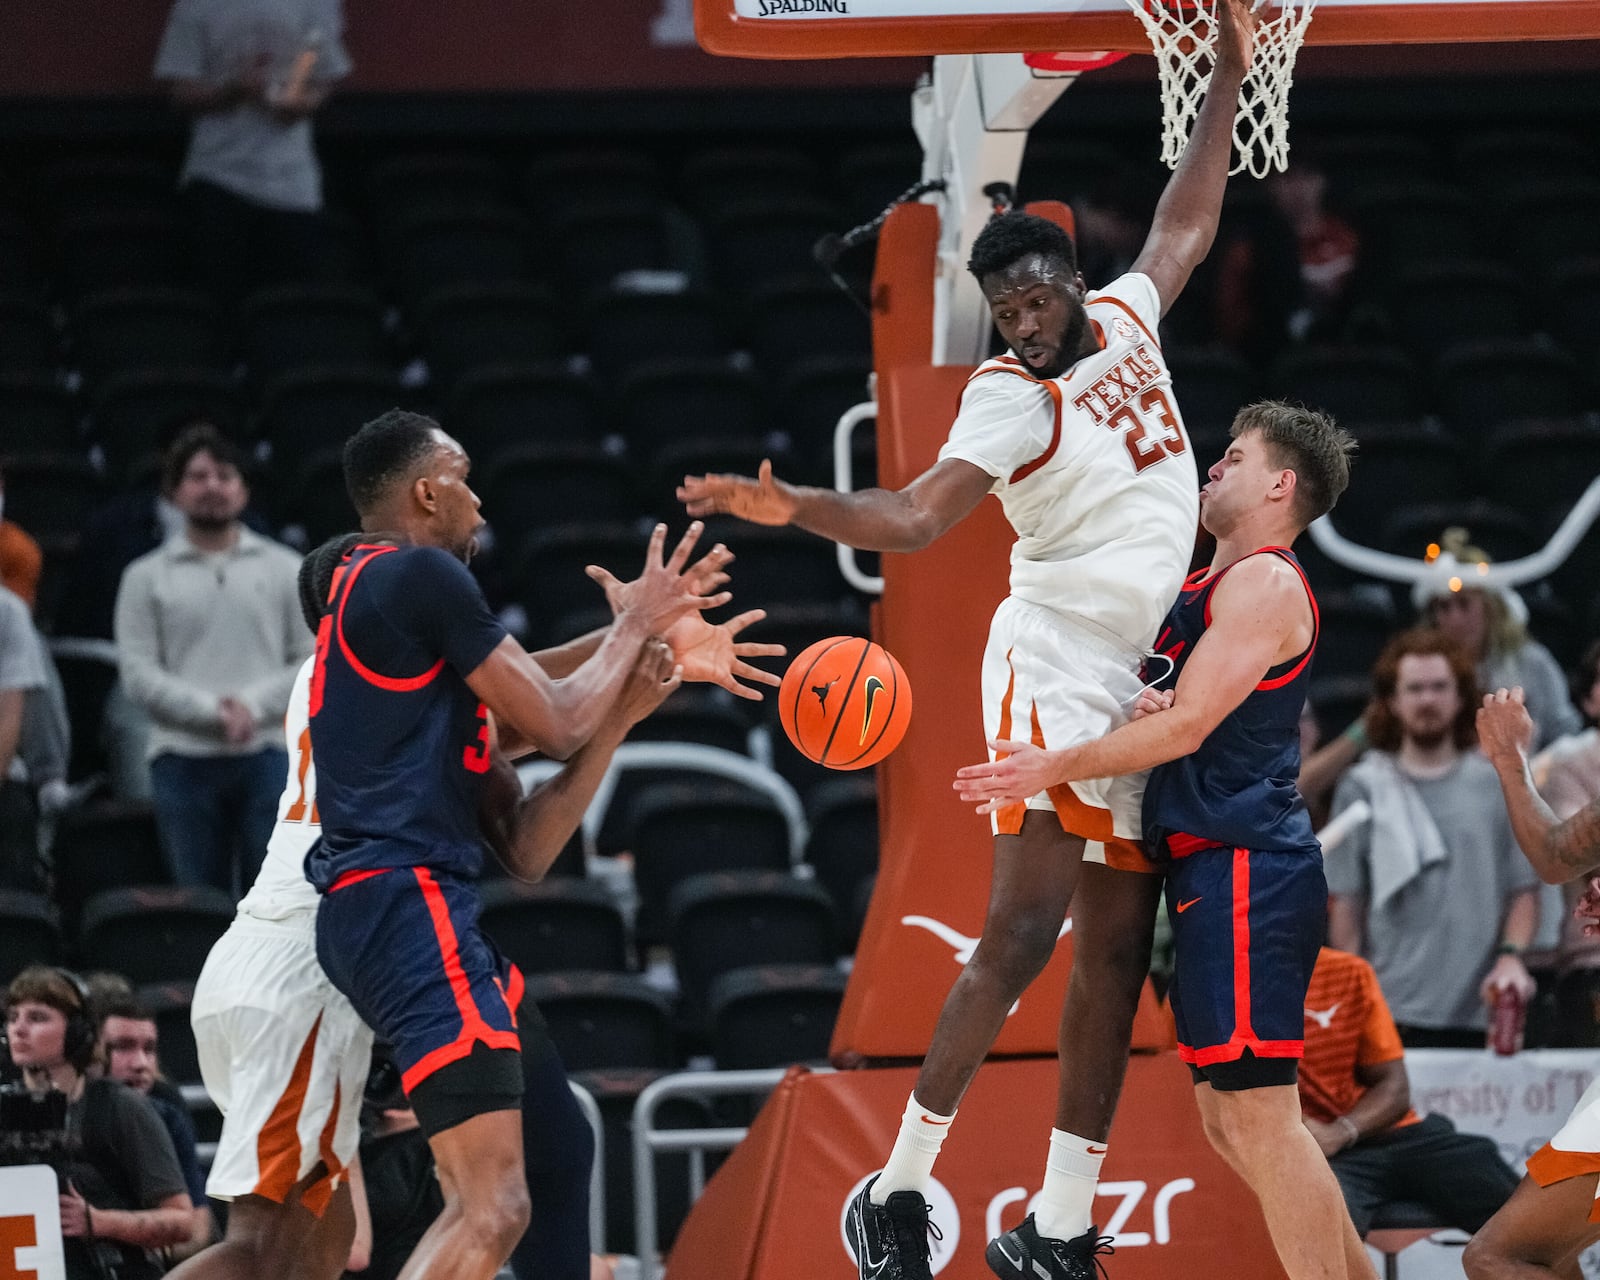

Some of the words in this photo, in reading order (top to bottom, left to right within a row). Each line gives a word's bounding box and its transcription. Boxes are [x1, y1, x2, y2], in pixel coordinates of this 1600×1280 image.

[758, 0, 850, 17] SPALDING
[1071, 343, 1162, 427] TEXAS
[1105, 385, 1186, 476] 23
[985, 1177, 1195, 1248] rzr
